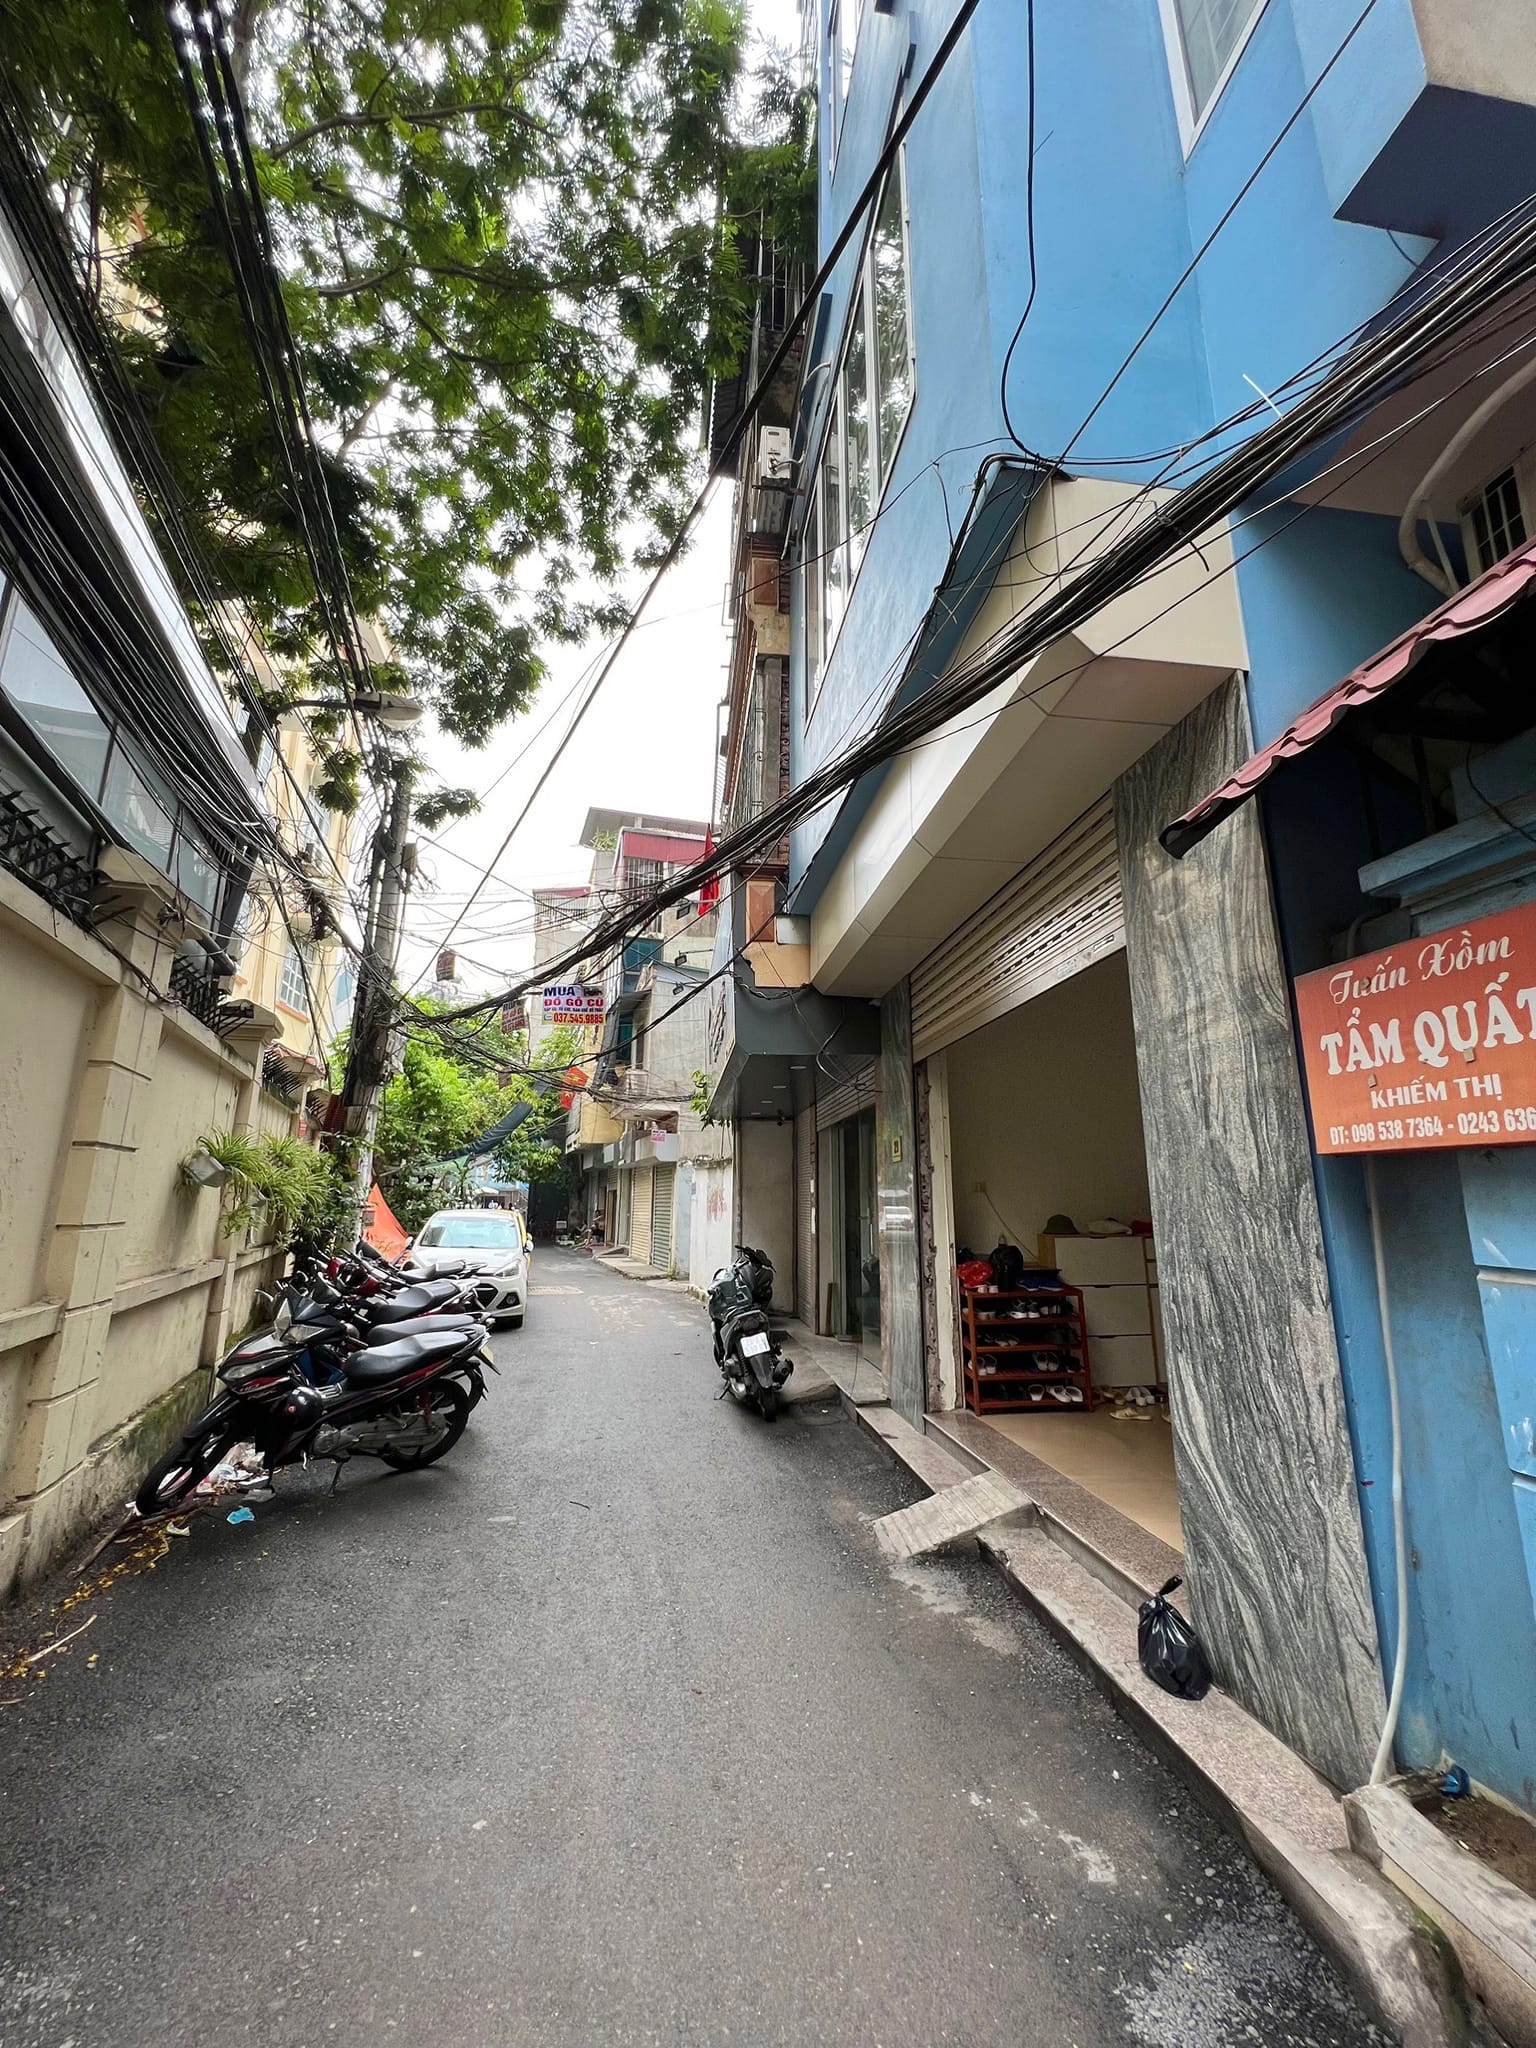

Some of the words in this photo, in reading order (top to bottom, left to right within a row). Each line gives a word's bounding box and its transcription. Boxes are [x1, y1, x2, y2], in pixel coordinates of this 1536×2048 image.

[1329, 956, 1410, 1005] Tuấn
[1418, 930, 1515, 981] Xồm
[544, 986, 576, 996] MUA
[1320, 1007, 1406, 1076] TẨM
[1370, 1075, 1448, 1109] KHIẾM
[1453, 1073, 1503, 1101] THỊ
[1352, 1122, 1376, 1144] 098
[1378, 1119, 1404, 1140] 538
[1406, 1115, 1444, 1138] 7364
[1457, 1110, 1500, 1136] 0243
